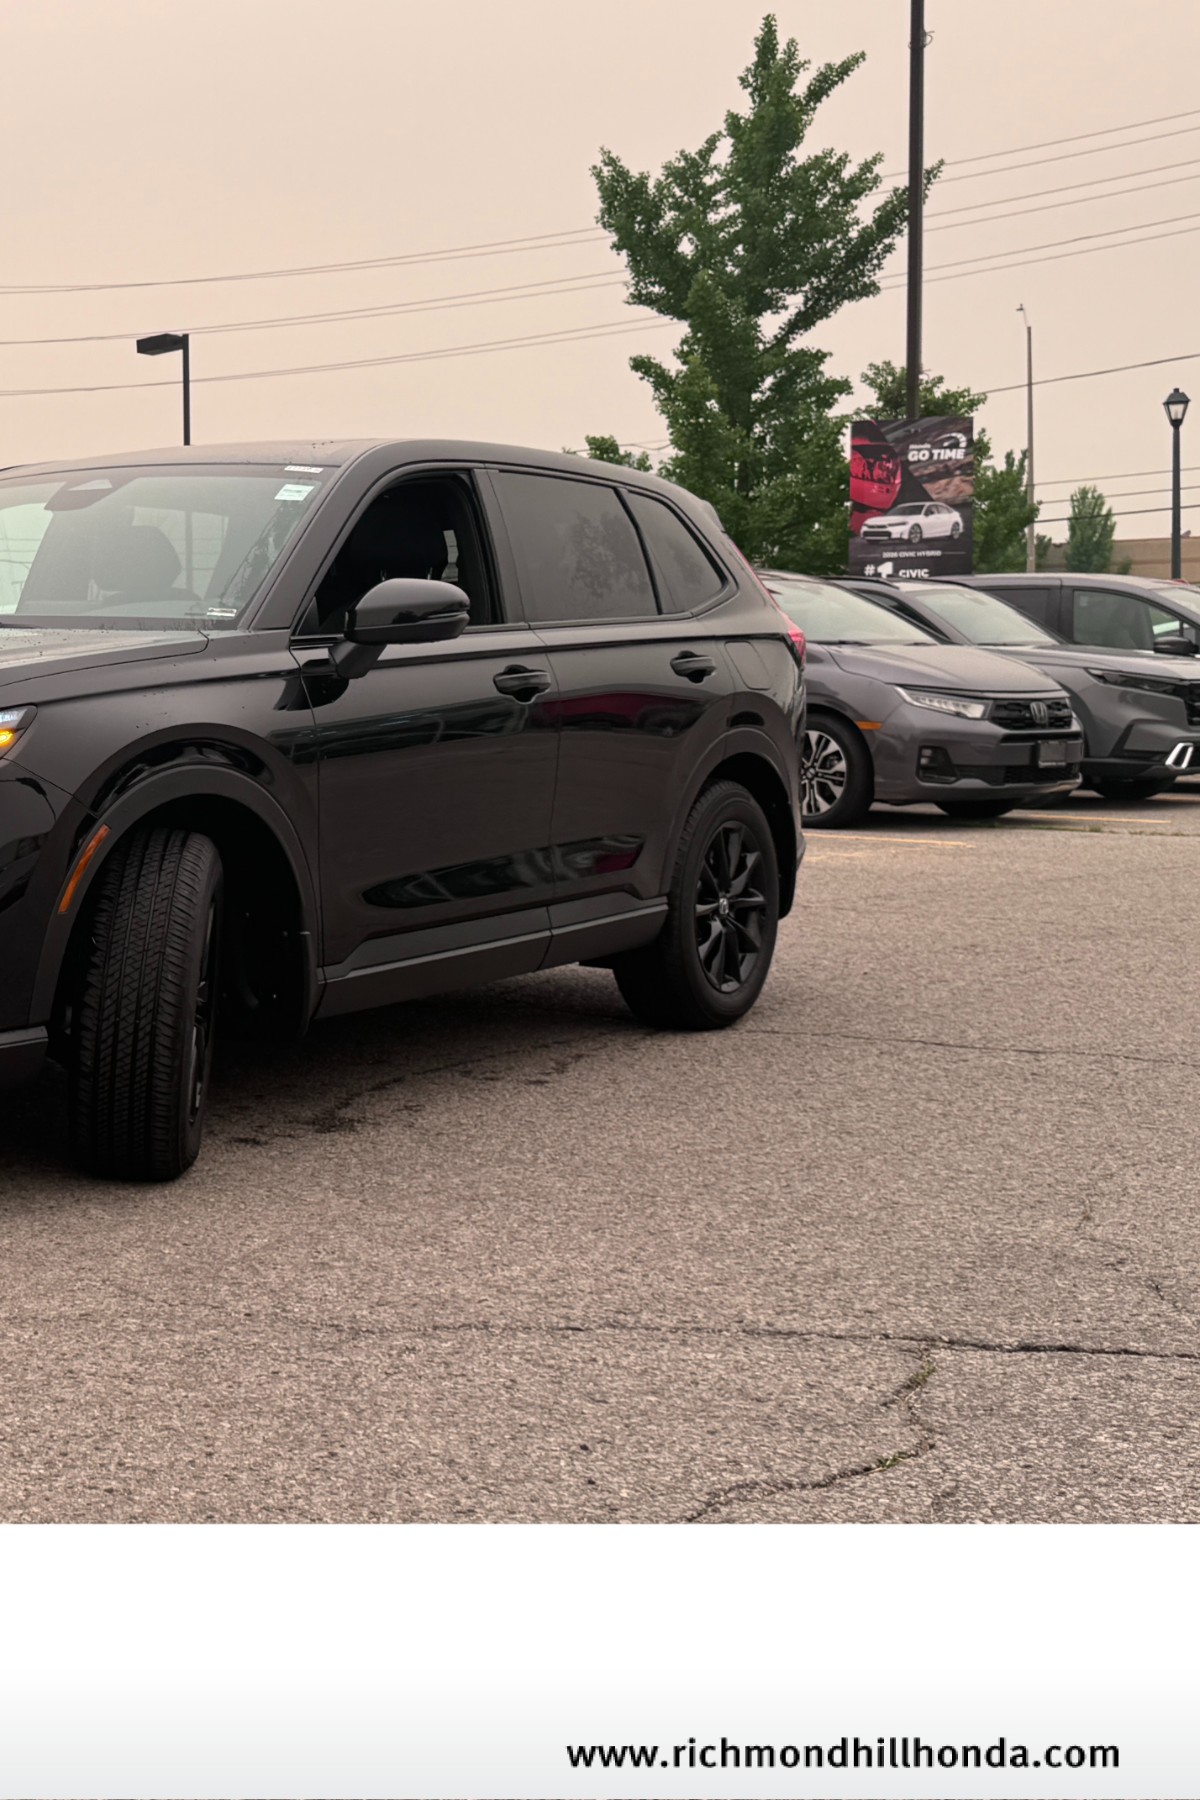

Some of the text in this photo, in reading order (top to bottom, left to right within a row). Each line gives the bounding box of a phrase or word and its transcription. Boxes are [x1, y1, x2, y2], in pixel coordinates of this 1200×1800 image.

[908, 448, 966, 462] GO TIME
[899, 569, 929, 578] CIVIC
